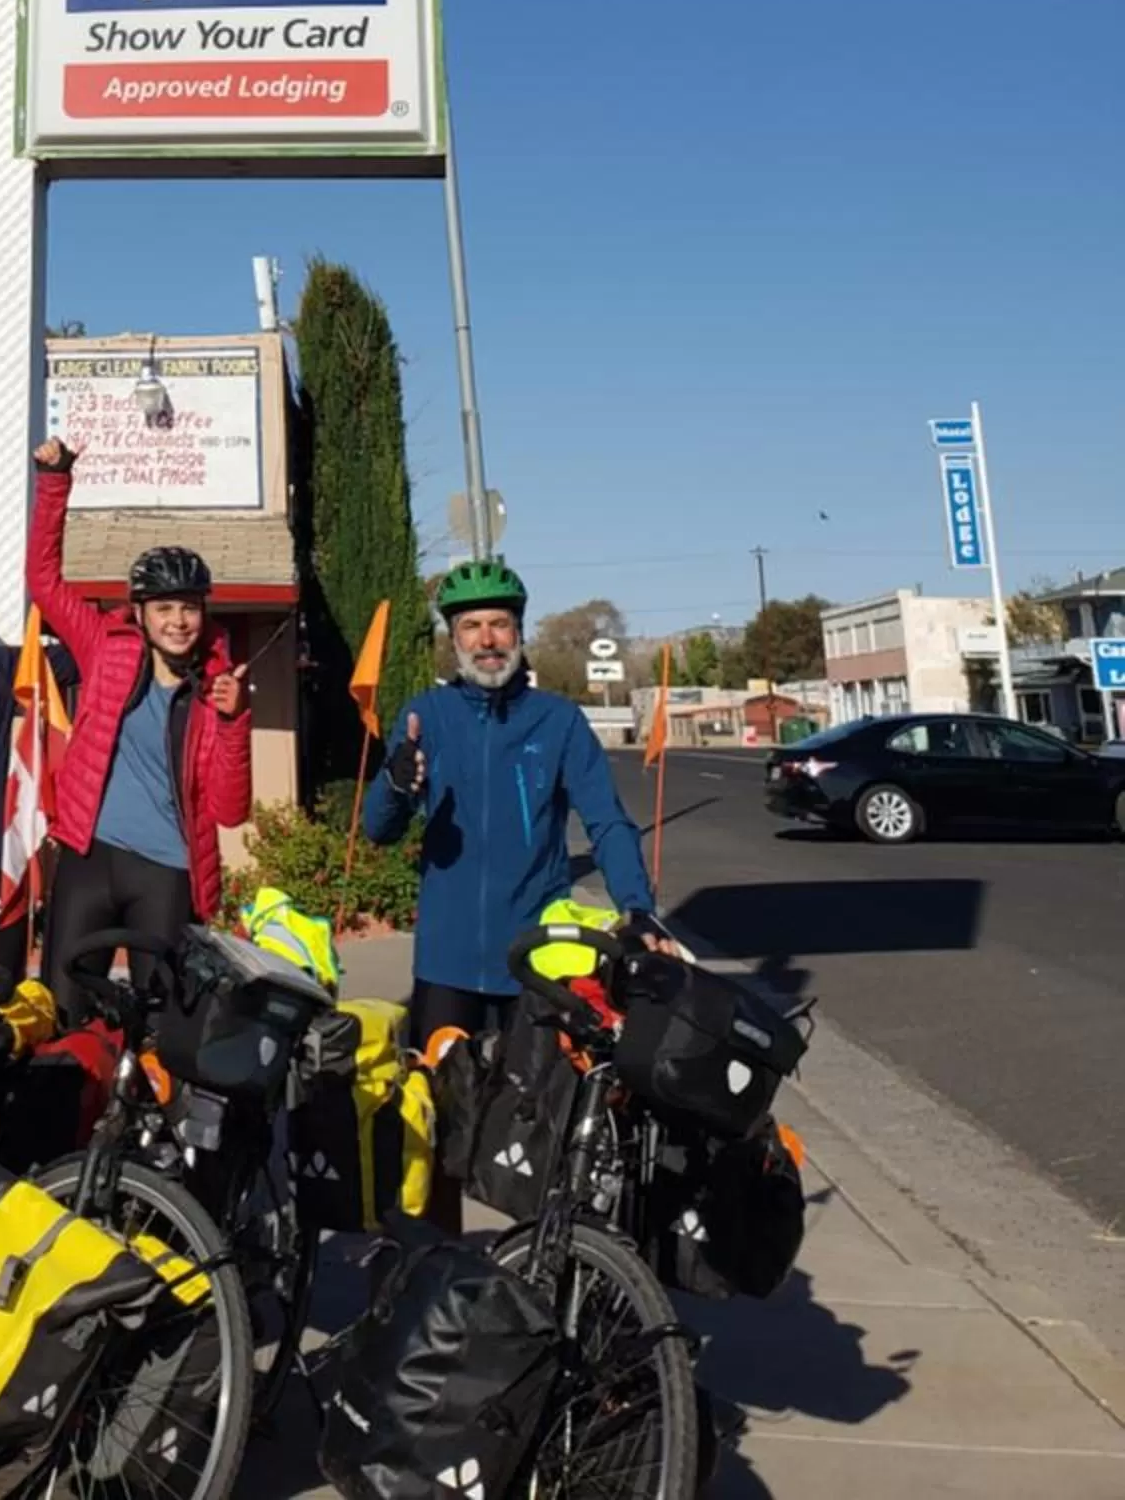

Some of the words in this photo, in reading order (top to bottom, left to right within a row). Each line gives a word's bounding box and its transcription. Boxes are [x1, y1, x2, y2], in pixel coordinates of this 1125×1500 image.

[85, 19, 186, 52] Show
[196, 19, 273, 50] Your
[283, 16, 368, 49] Card
[103, 74, 230, 103] Approved
[237, 73, 347, 103] Lodging
